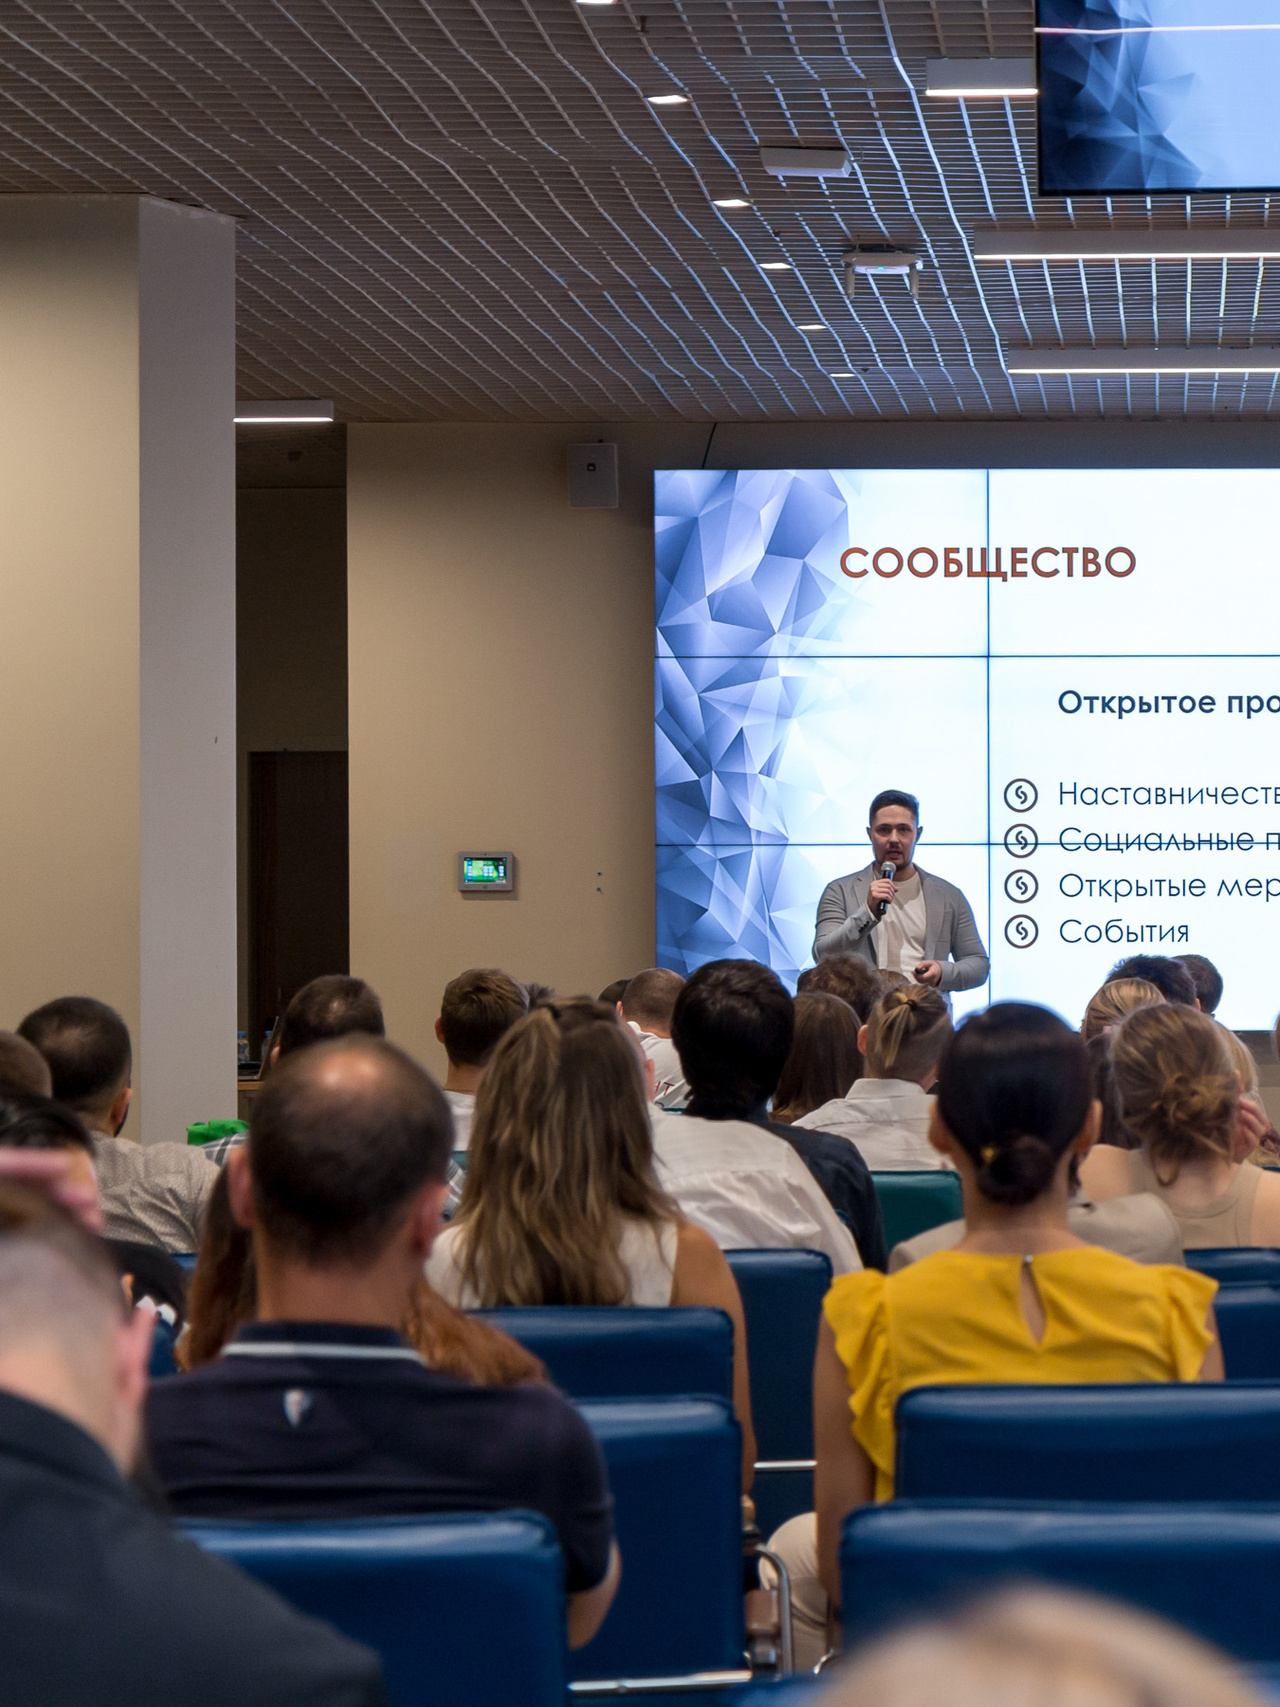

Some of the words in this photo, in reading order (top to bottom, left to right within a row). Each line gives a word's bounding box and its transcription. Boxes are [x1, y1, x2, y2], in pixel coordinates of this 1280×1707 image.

[839, 546, 1136, 583] СООБЩЕСТВО
[1057, 689, 1217, 720] Открытое
[1058, 827, 1255, 854] Социальные
[1058, 873, 1207, 903] Открытые
[1058, 918, 1190, 944] События
